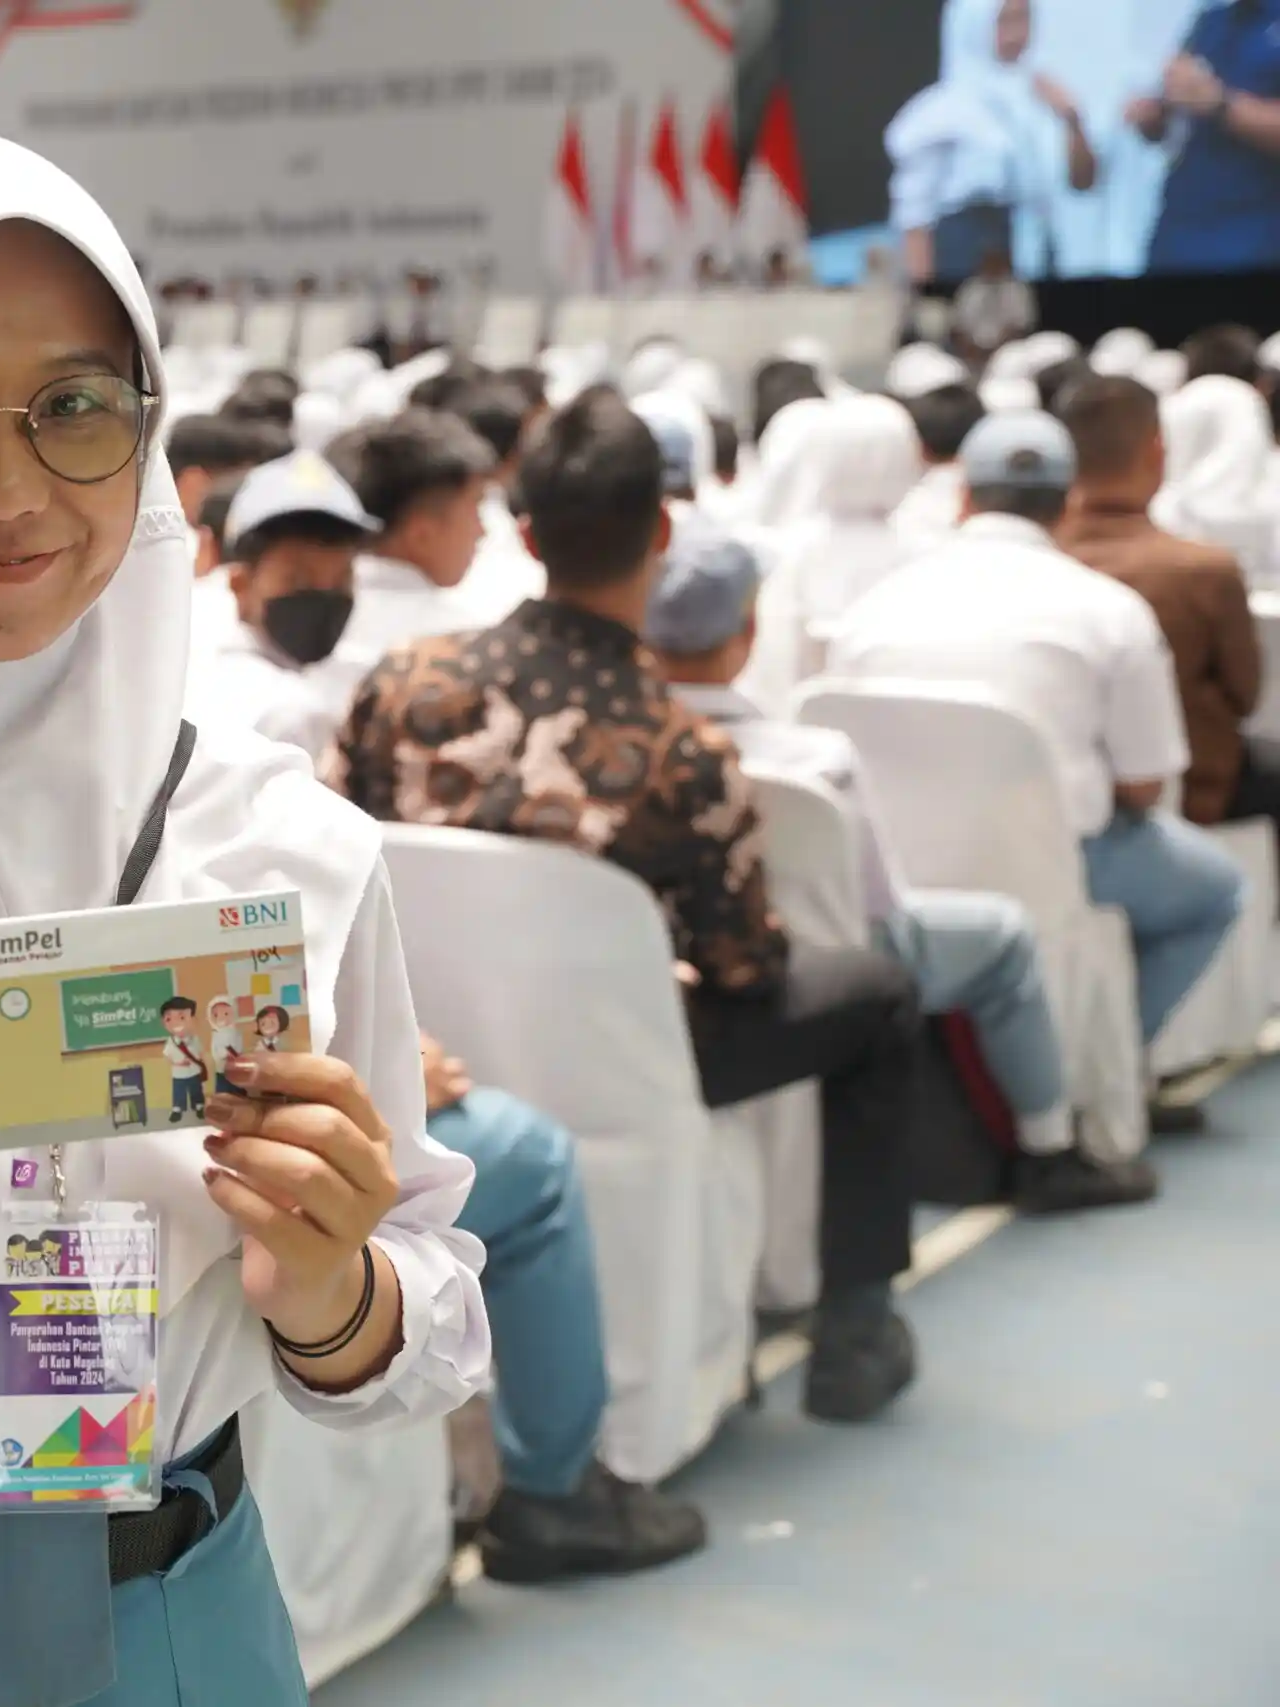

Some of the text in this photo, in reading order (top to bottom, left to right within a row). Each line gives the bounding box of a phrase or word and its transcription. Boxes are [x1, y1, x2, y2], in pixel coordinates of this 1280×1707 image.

[243, 901, 287, 926] BNI
[251, 944, 282, 973] 104
[91, 1007, 137, 1023] SimPel
[39, 1355, 48, 1369] di
[50, 1371, 104, 1385] Tahun 2024
